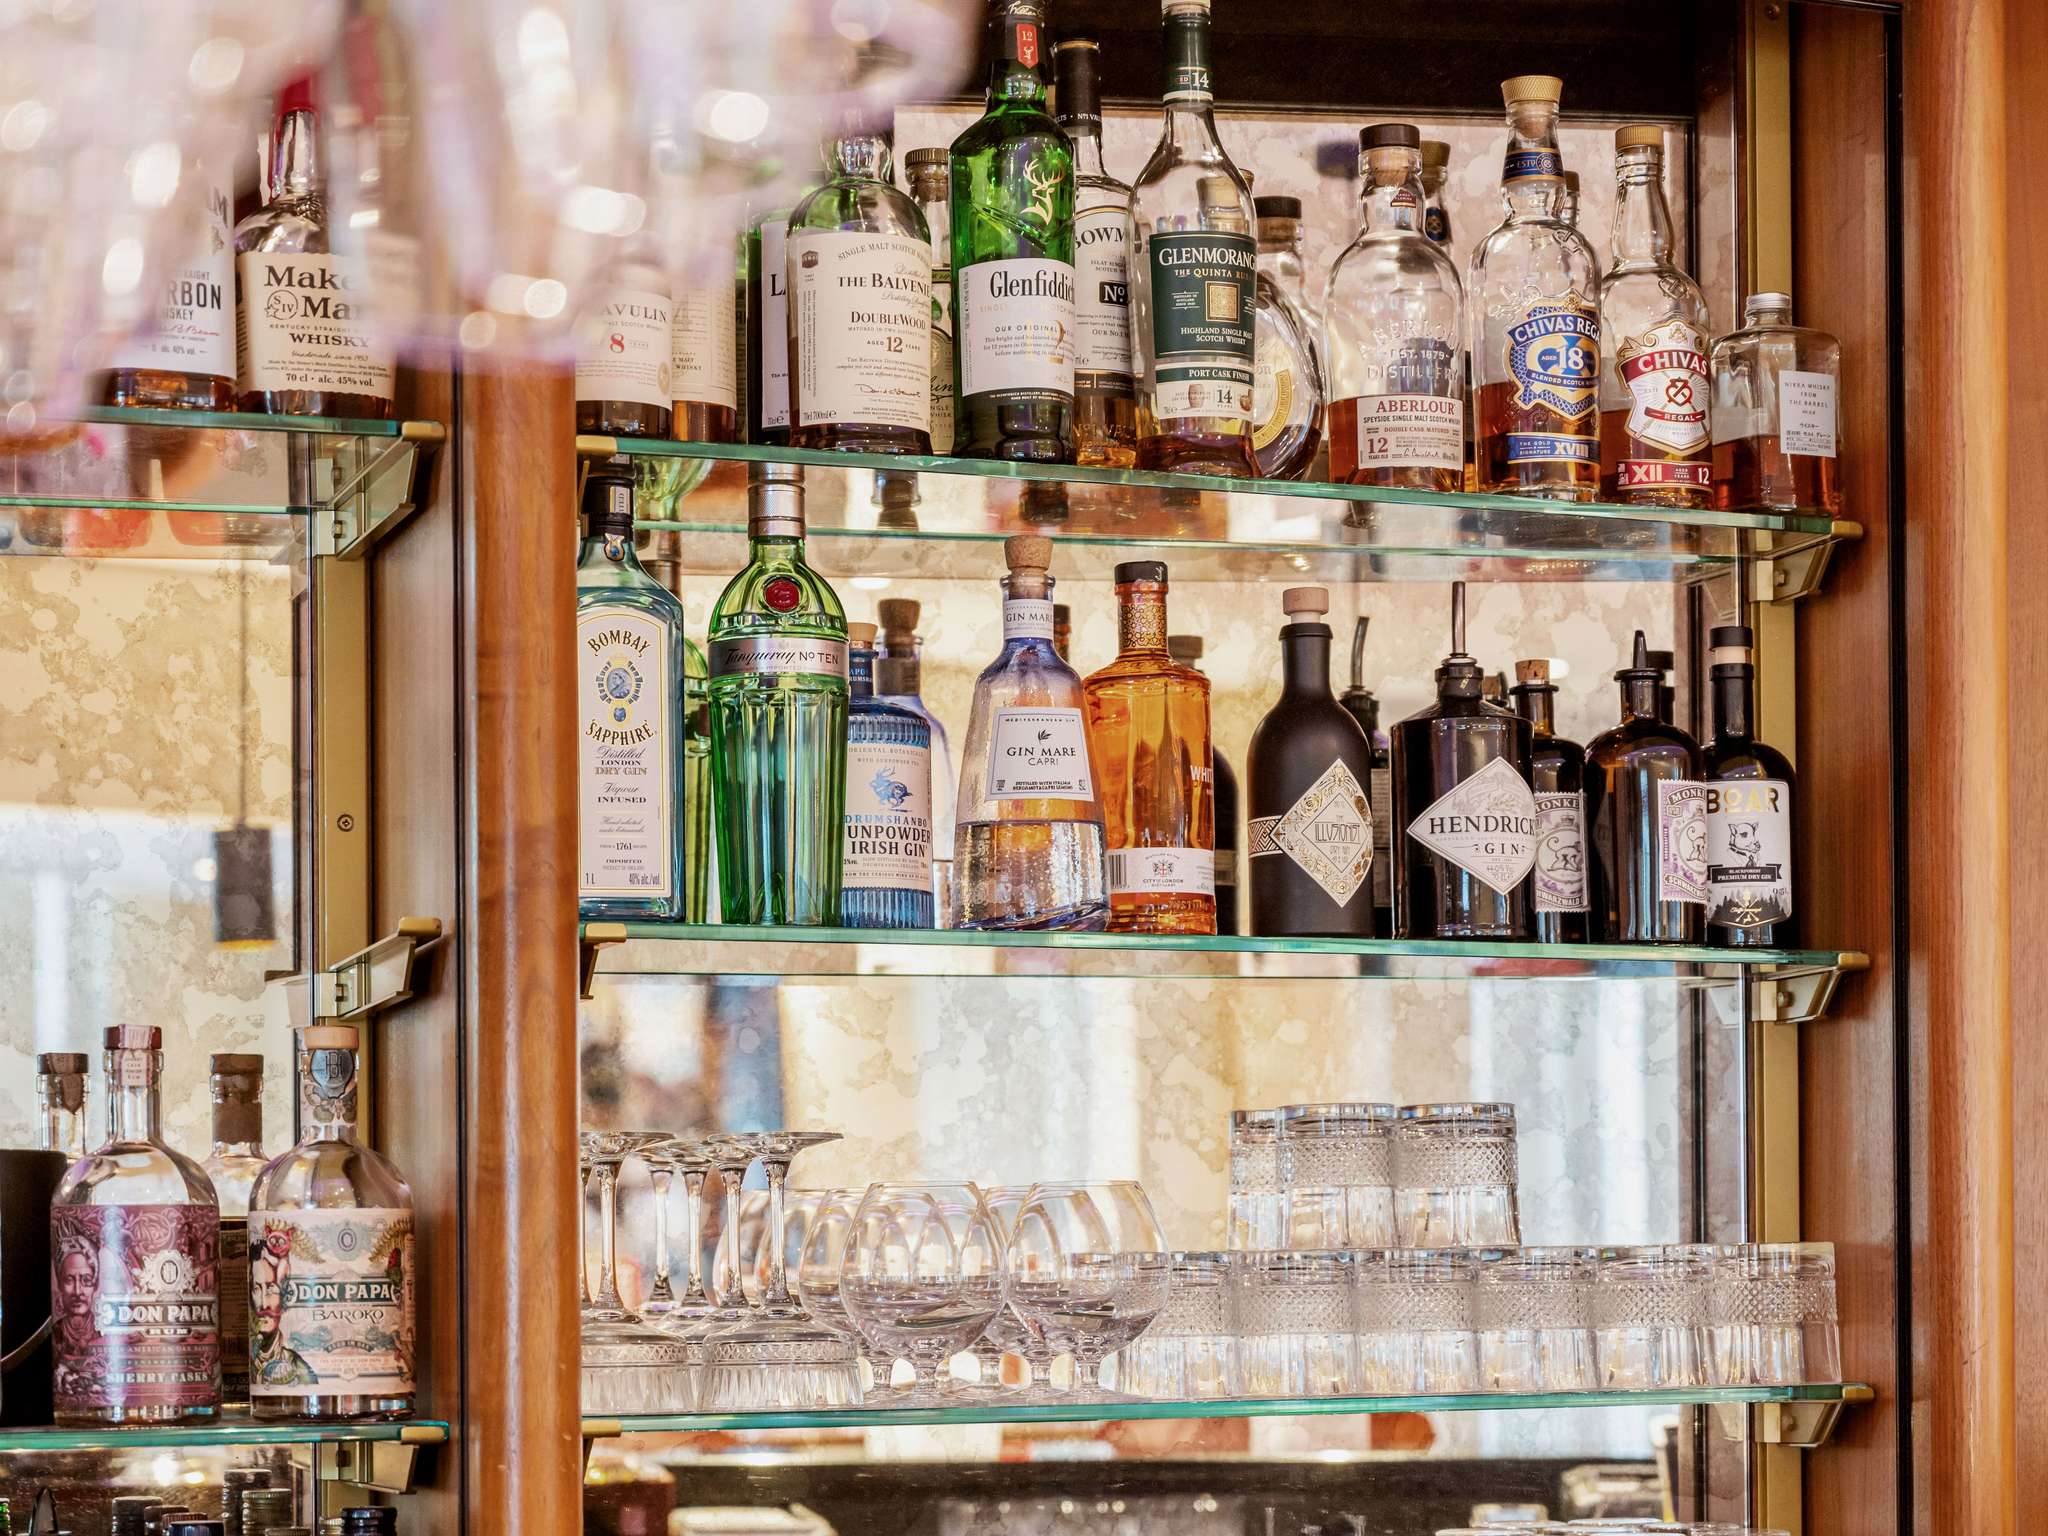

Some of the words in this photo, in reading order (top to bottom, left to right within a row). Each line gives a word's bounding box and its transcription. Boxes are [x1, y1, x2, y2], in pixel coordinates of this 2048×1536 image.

[1022, 30, 1033, 41] 12
[1192, 72, 1209, 88] 14
[868, 242, 890, 251] MALT
[1159, 246, 1256, 273] GLENMORANG
[264, 265, 356, 292] Make
[1174, 268, 1191, 277] THE
[1193, 267, 1233, 279] QUINTA
[837, 276, 867, 288] THE
[167, 280, 222, 310] RBON
[601, 303, 667, 323] AVULIN
[995, 325, 1013, 333] OUR
[1016, 324, 1058, 333] ORIGINAL
[1180, 327, 1220, 335] HIGHLAND
[1221, 327, 1243, 337] SINGLE
[1514, 316, 1575, 343] CHIVAS
[289, 332, 370, 348] WHISKY
[609, 332, 625, 354] 8
[886, 336, 903, 353] 12
[1196, 334, 1224, 343] SCOTCH
[1225, 335, 1246, 345] WHISKY
[1556, 345, 1585, 371] 18
[1638, 351, 1708, 376] CHIVAS
[286, 373, 297, 382] 70
[299, 373, 308, 383] cl
[318, 374, 335, 385] alc.
[336, 375, 357, 386] 45%
[359, 377, 375, 387] vol.
[1188, 368, 1211, 378] PORT
[1211, 368, 1231, 379] CASK
[1531, 371, 1562, 384] BLENDED
[1563, 379, 1586, 387] SCOTCH
[1216, 389, 1233, 404] 14
[1804, 400, 1828, 409] BARREL
[1376, 399, 1456, 415] ABERLOUR
[1363, 415, 1391, 424] SPEYSIDE
[1392, 414, 1413, 423] SINGLE
[1429, 415, 1448, 424] SCOTCH
[1664, 413, 1695, 422] REGAL
[1367, 436, 1389, 455] 12
[1553, 441, 1590, 458] XVIII
[1631, 464, 1663, 483] XII
[1697, 467, 1710, 485] 12
[1006, 612, 1026, 623] GIN
[1028, 612, 1053, 625] MARE
[587, 629, 651, 657] BOMBAY
[725, 647, 796, 666] Tanqueray
[817, 652, 839, 665] TEN
[585, 720, 655, 746] SAPPHIRE
[596, 747, 646, 759] Distilled
[848, 746, 887, 754] ORIENTAL
[1006, 746, 1035, 757] GIN
[1041, 746, 1077, 757] MARE
[1028, 757, 1060, 766] CAPRI
[594, 767, 621, 776] DRY
[623, 767, 648, 776] GIN
[603, 782, 639, 795] Vapour
[597, 796, 647, 804] INFUSED
[1706, 787, 1780, 814] BOAR
[844, 814, 928, 828] DRUMSHANBO
[847, 824, 932, 844] UNPOWDER
[616, 842, 632, 850] 1761
[850, 840, 900, 856] IRISH
[904, 842, 926, 858] GIN
[1484, 842, 1520, 855] GIN
[298, 1284, 340, 1300] DON
[344, 1284, 390, 1300] PAPA
[118, 1305, 164, 1323] DON
[166, 1304, 211, 1323] PAPA
[312, 1309, 385, 1325] BAROKO
[105, 1371, 166, 1383] SHERRY
[170, 1371, 209, 1383] CASKS
